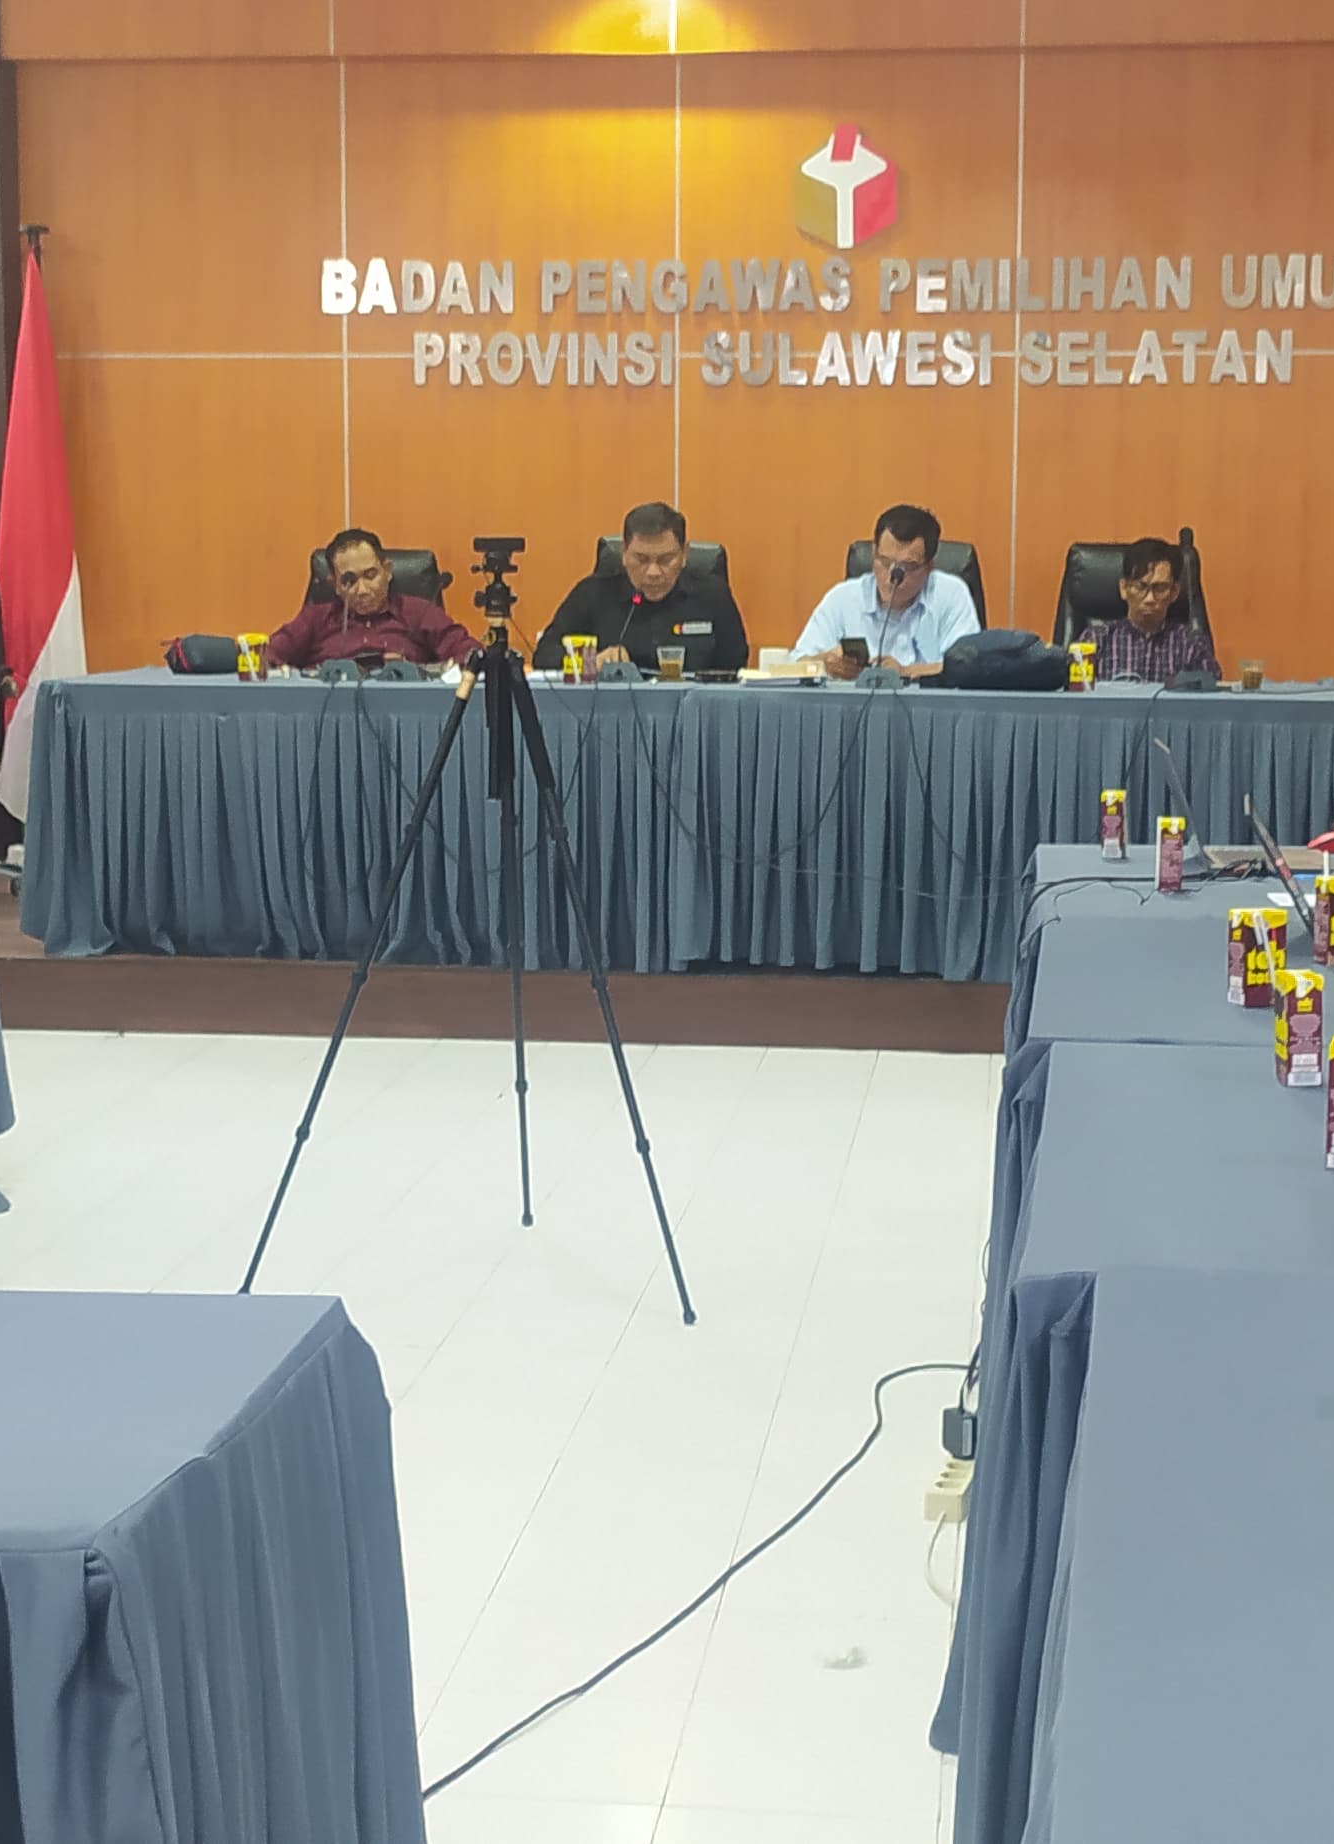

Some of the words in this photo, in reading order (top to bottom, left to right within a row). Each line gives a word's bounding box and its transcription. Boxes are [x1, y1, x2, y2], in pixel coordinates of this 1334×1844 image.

[320, 257, 515, 315] BADAN
[540, 258, 853, 314] PENGAWAS
[878, 256, 1192, 313] PEMILIHAN
[413, 330, 671, 387] PROVINSI
[700, 329, 990, 388] SULAWESI
[1019, 328, 1294, 385] SELATAN
